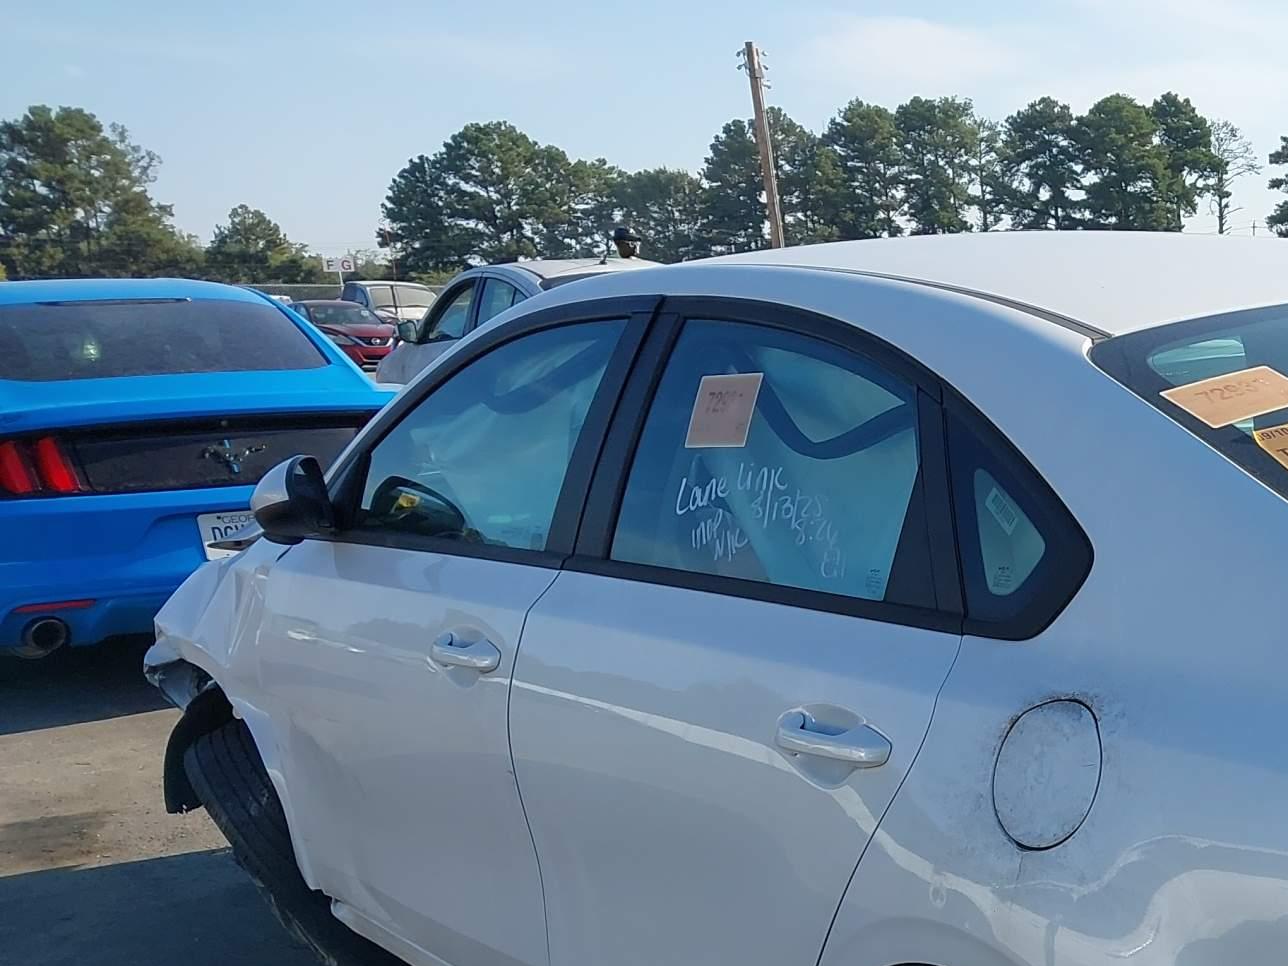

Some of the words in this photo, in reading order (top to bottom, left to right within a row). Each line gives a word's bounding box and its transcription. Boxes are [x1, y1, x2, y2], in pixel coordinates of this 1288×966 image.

[326, 259, 335, 271] F
[341, 259, 352, 271] G
[676, 477, 730, 516] Lane
